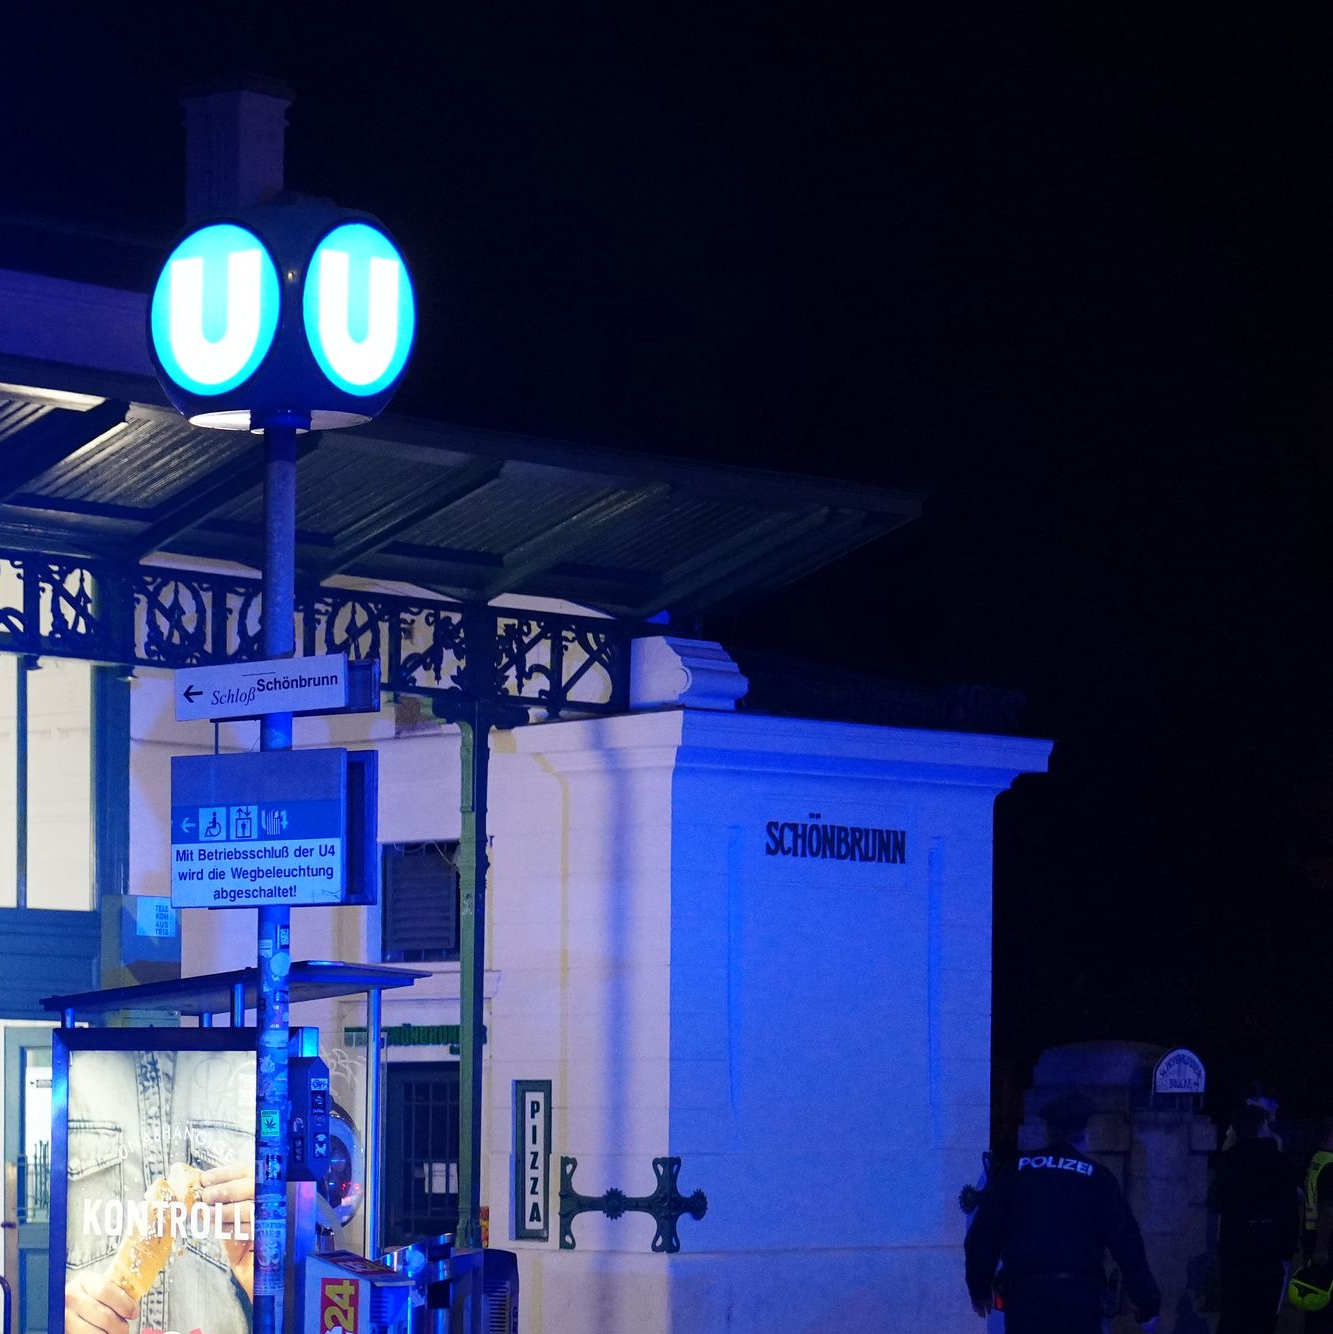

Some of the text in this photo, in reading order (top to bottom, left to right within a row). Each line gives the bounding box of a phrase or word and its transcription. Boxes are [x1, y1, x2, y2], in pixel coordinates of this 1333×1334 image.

[170, 249, 262, 385] U
[319, 249, 400, 385] U
[211, 673, 338, 706] Schloß Schönbrunn
[175, 844, 335, 862] Mit Betriebsschluß der U4
[765, 813, 907, 864] SCHÖNBRUNN
[178, 865, 334, 882] wird die Wegbeleuchtung
[213, 884, 297, 900] abgeschaltet!
[529, 1100, 541, 1222] PIZZA
[1018, 1156, 1093, 1176] POLIZEI
